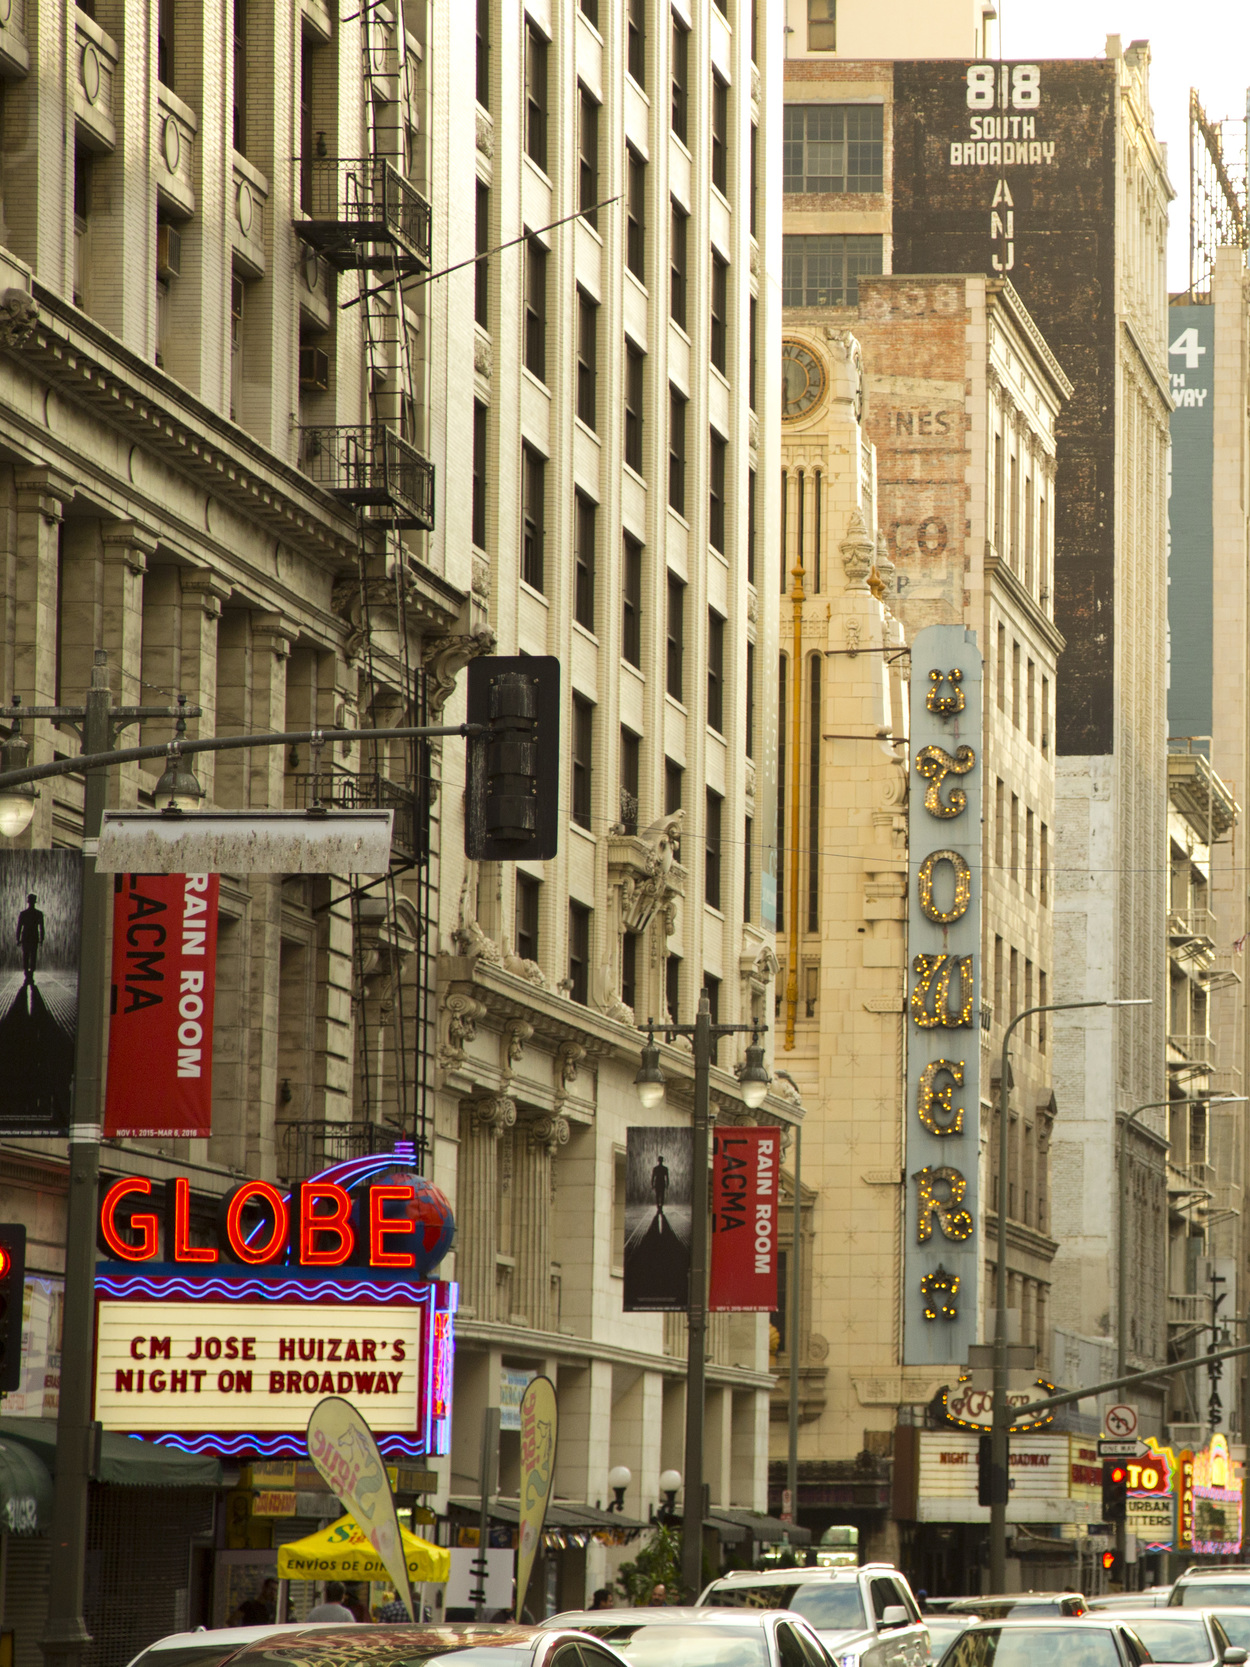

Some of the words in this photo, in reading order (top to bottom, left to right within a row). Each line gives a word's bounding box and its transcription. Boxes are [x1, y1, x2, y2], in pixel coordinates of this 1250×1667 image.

[966, 65, 1041, 109] 818
[970, 116, 1036, 140] SOUTH
[950, 141, 1055, 165] BROADWAY
[991, 179, 1015, 277] ANJ
[182, 873, 210, 955] RAIN
[124, 873, 168, 1014] LACMA
[910, 744, 976, 1244] TOWER
[177, 970, 205, 1079] ROOM
[116, 1129, 131, 1137] NOV
[181, 1129, 197, 1138] 2016
[720, 1138, 749, 1234] LACMA
[756, 1139, 774, 1195] RAIN
[100, 1177, 416, 1268] GLOBE
[754, 1203, 772, 1274] ROOM
[130, 1336, 171, 1360] CM
[187, 1337, 256, 1361] JOSE
[279, 1338, 406, 1362] HUIZAR'S
[116, 1369, 206, 1394] NIGHT
[218, 1370, 252, 1393] ON
[269, 1371, 403, 1394] BROADWAY
[939, 1452, 969, 1464] NIGHT
[1009, 1454, 1051, 1466] OADWAY
[1120, 1445, 1136, 1453] WAY
[1126, 1464, 1159, 1489] TO
[1128, 1501, 1170, 1512] URBAN
[1183, 1463, 1193, 1542] RIALTO
[286, 1558, 337, 1571] ENVÍOS
[341, 1560, 360, 1571] DE
[364, 1561, 419, 1572] DINO
